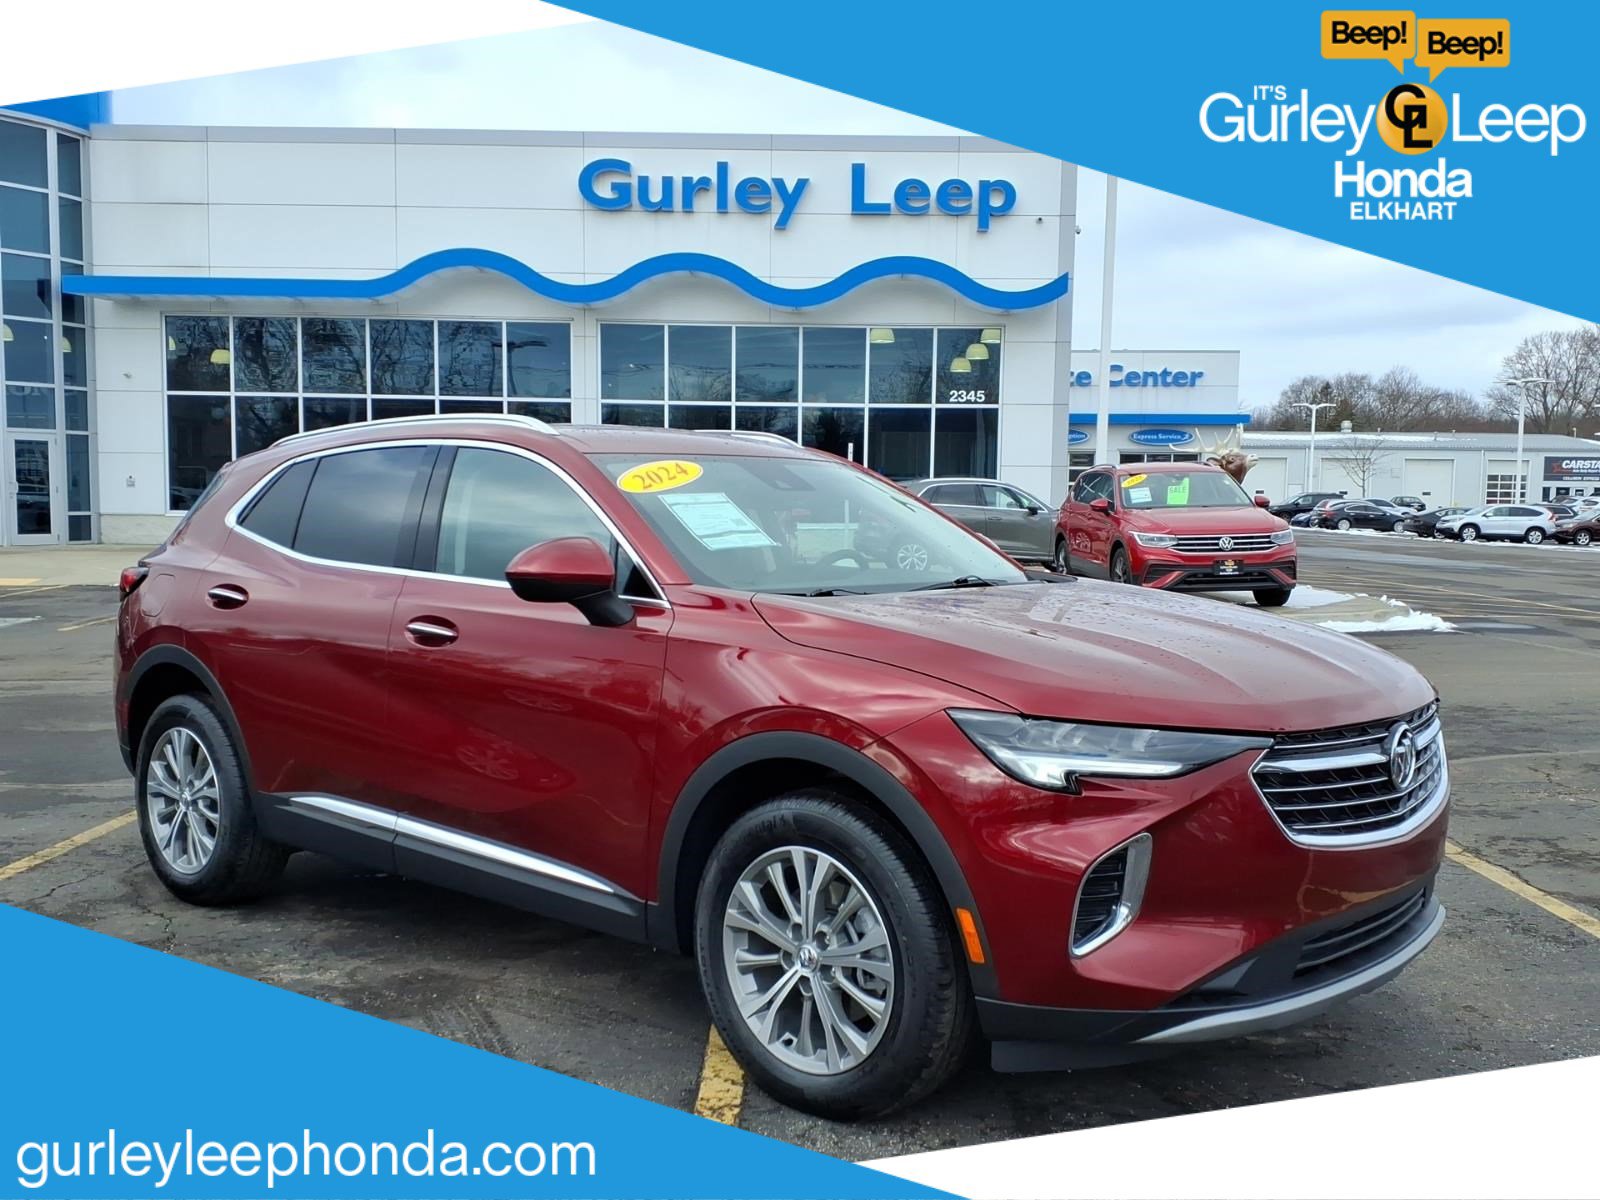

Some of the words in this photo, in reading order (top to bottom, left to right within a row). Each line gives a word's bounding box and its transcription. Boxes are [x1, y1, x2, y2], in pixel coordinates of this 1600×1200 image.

[577, 157, 811, 230] Gurley
[849, 162, 1019, 232] Leep
[949, 389, 986, 403] 2345
[631, 462, 689, 490] 2024
[1169, 486, 1187, 494] SALE
